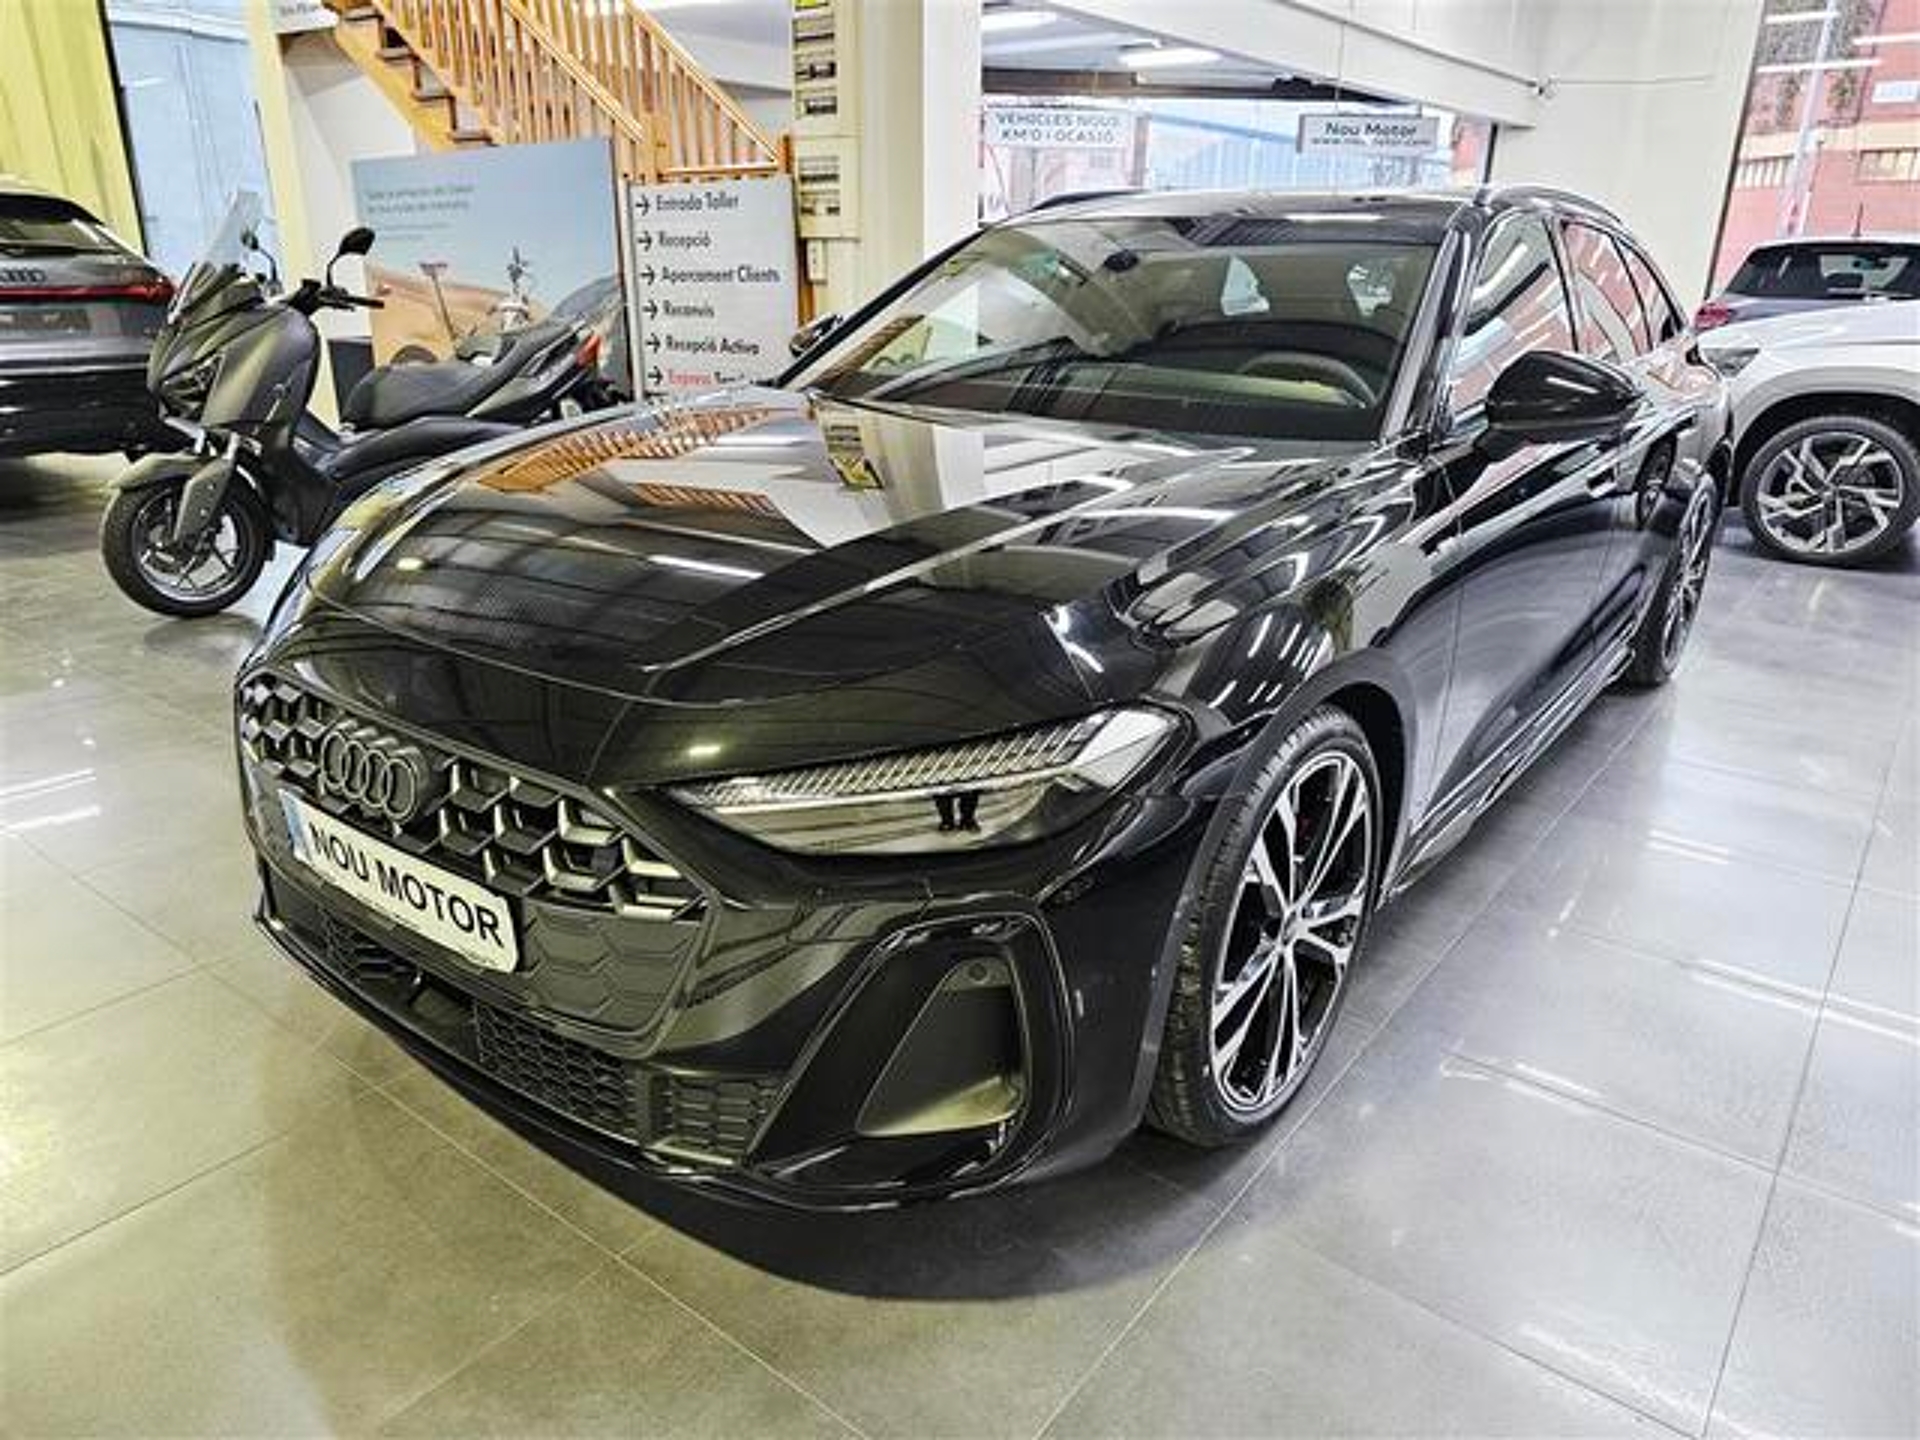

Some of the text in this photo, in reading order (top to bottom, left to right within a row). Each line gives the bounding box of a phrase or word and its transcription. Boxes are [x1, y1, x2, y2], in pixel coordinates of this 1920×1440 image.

[1325, 122, 1416, 137] Nou Motor
[656, 191, 739, 211] Entrada Taller
[658, 231, 710, 248] Recepció
[661, 264, 780, 284] Aparcament Clients
[665, 336, 717, 353] Recepció
[309, 821, 505, 948] NOU MOTOR
